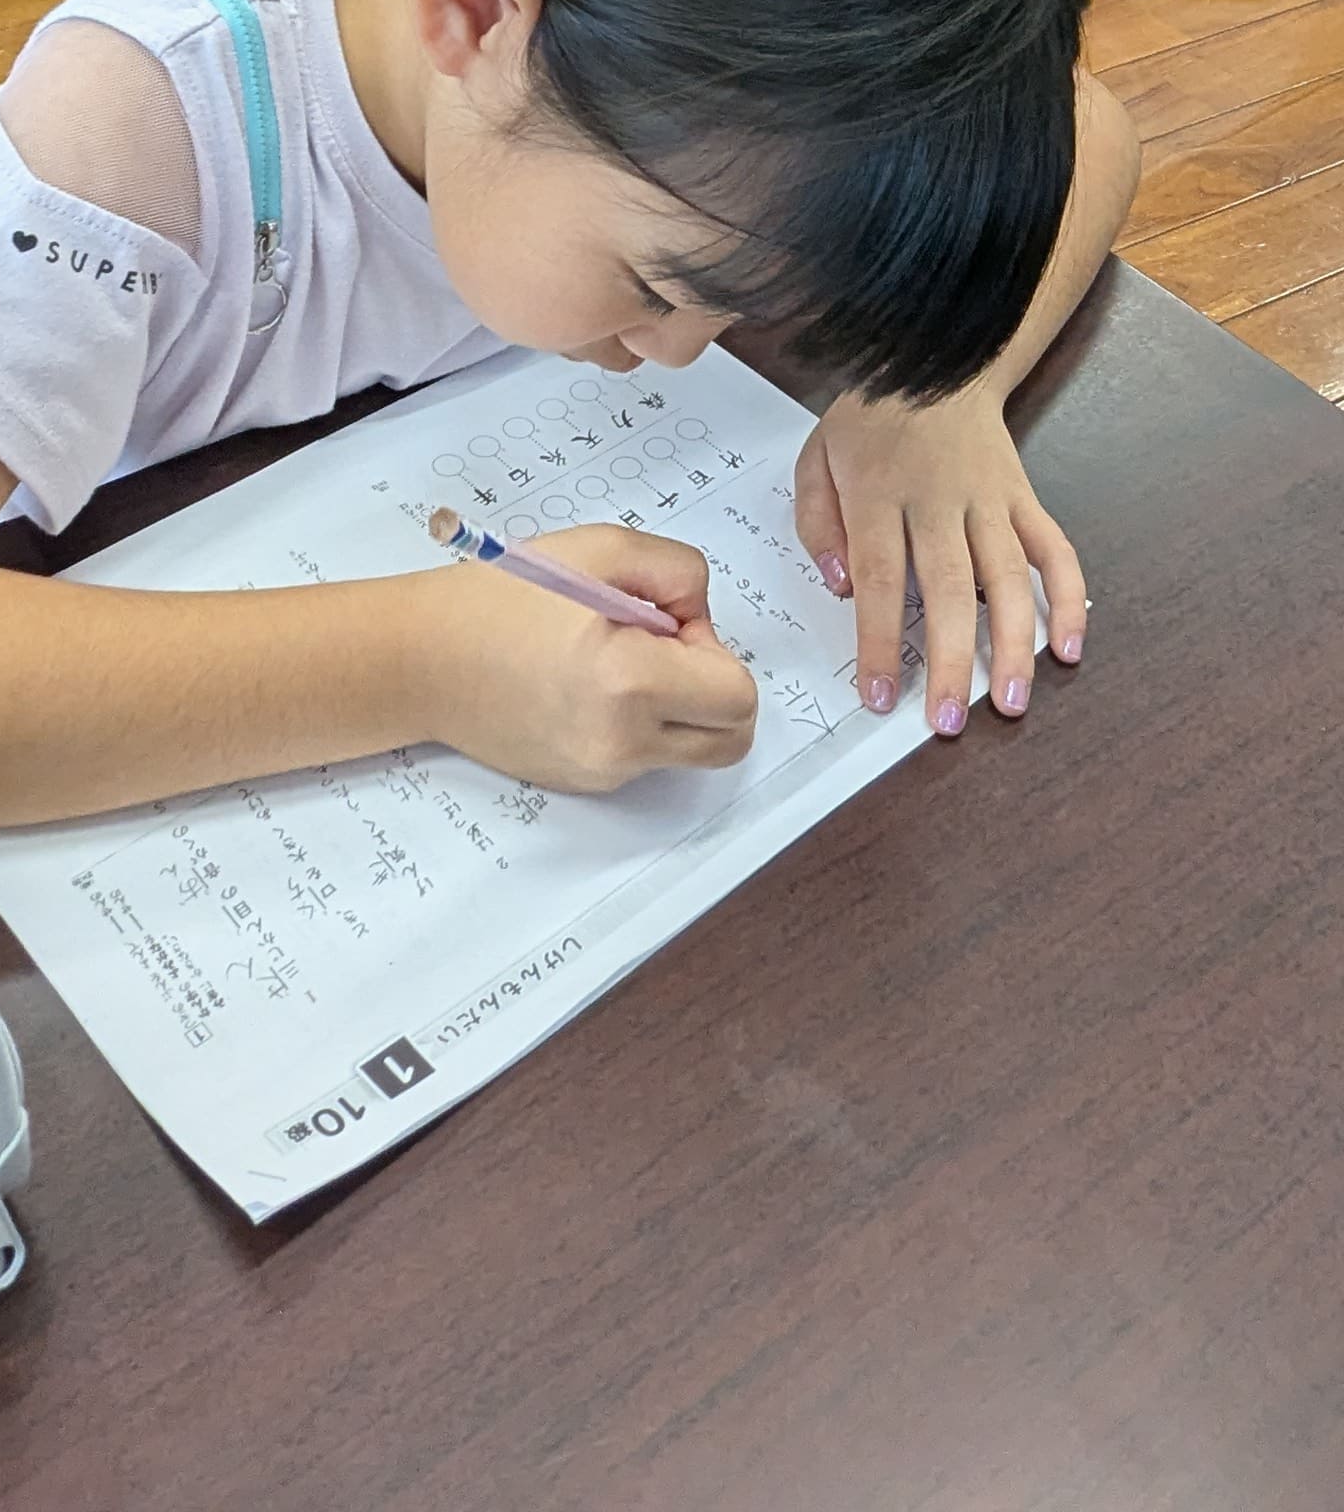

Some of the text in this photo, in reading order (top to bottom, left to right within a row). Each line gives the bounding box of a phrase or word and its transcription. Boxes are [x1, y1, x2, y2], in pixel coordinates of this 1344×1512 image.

[611, 409, 635, 430] 力
[508, 467, 537, 488] 石
[687, 469, 715, 489] 百
[472, 486, 499, 507] 年
[496, 856, 508, 869] 2
[437, 937, 582, 1043] しけんもんだい
